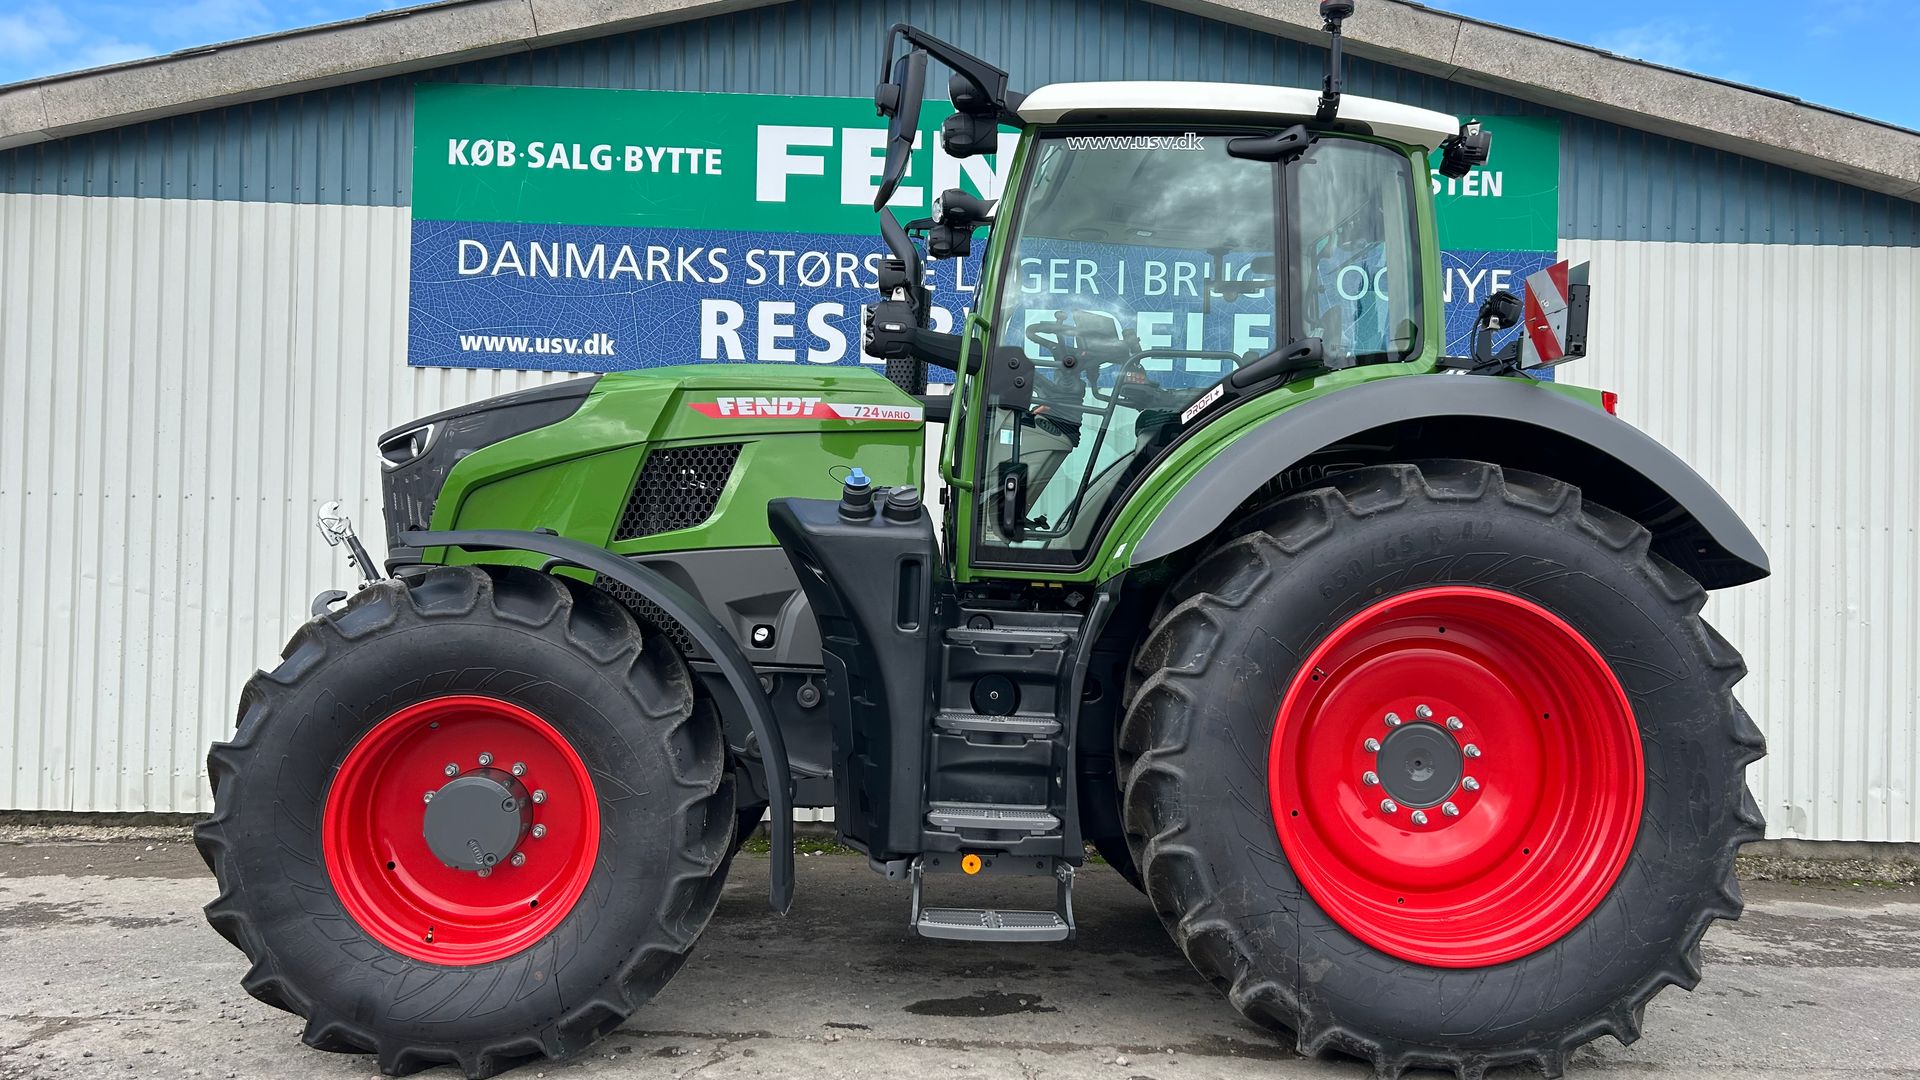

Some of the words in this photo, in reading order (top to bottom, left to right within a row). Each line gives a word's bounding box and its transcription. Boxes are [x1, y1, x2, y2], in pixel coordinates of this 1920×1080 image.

[1066, 132, 1204, 150] www.usv.dk
[457, 239, 729, 285] DANMARKS
[745, 249, 936, 291] STØRSE
[459, 331, 615, 356] www.usv.dk
[716, 397, 822, 416] FENDT
[853, 406, 880, 418] 724
[881, 410, 911, 420] VARIO
